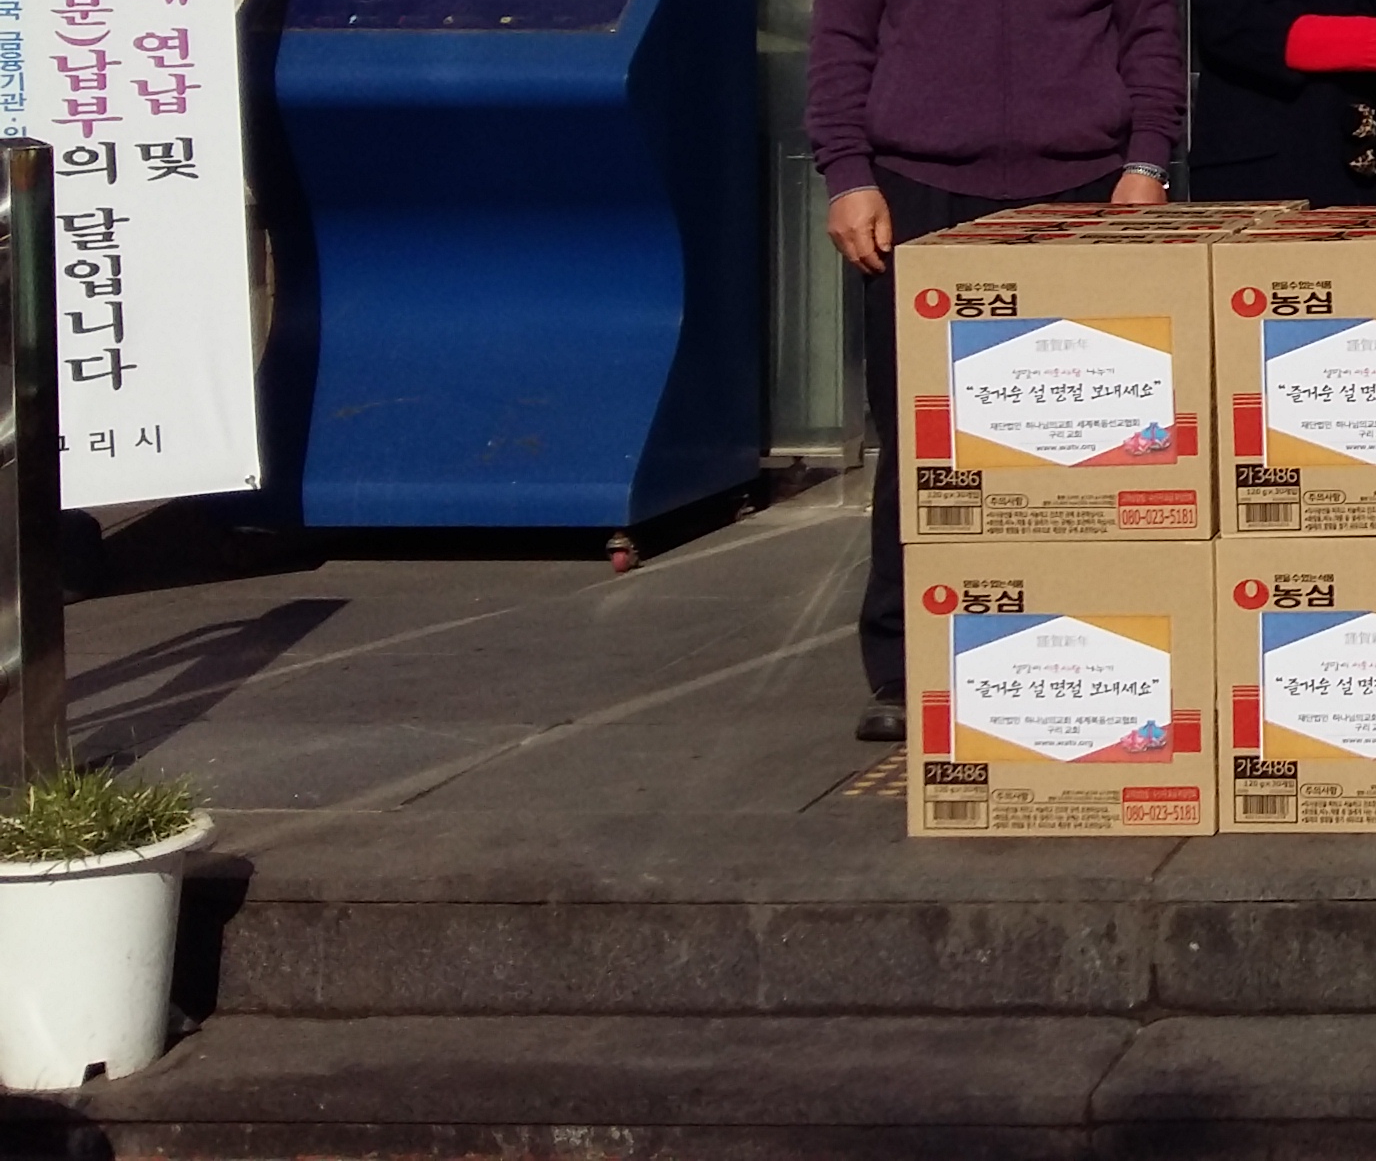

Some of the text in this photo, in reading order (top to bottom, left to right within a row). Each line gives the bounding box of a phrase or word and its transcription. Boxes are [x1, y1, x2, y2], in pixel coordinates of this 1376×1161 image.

[131, 30, 201, 120] 연납
[133, 138, 200, 181] 및
[55, 202, 138, 394] 달입니다
[954, 293, 1018, 317] 농심
[1270, 291, 1333, 315] 농심
[1028, 385, 1046, 404] 설
[1050, 383, 1084, 403] 명절
[919, 470, 980, 488] 가3486
[1238, 467, 1298, 485] 가3486
[1122, 508, 1194, 525] 080-023-5181
[962, 590, 1024, 614] 농심
[1273, 584, 1335, 608] 농심
[925, 764, 987, 782] 가3486
[1236, 759, 1295, 776] 가3486
[1125, 804, 1197, 821] 080-023-5181
